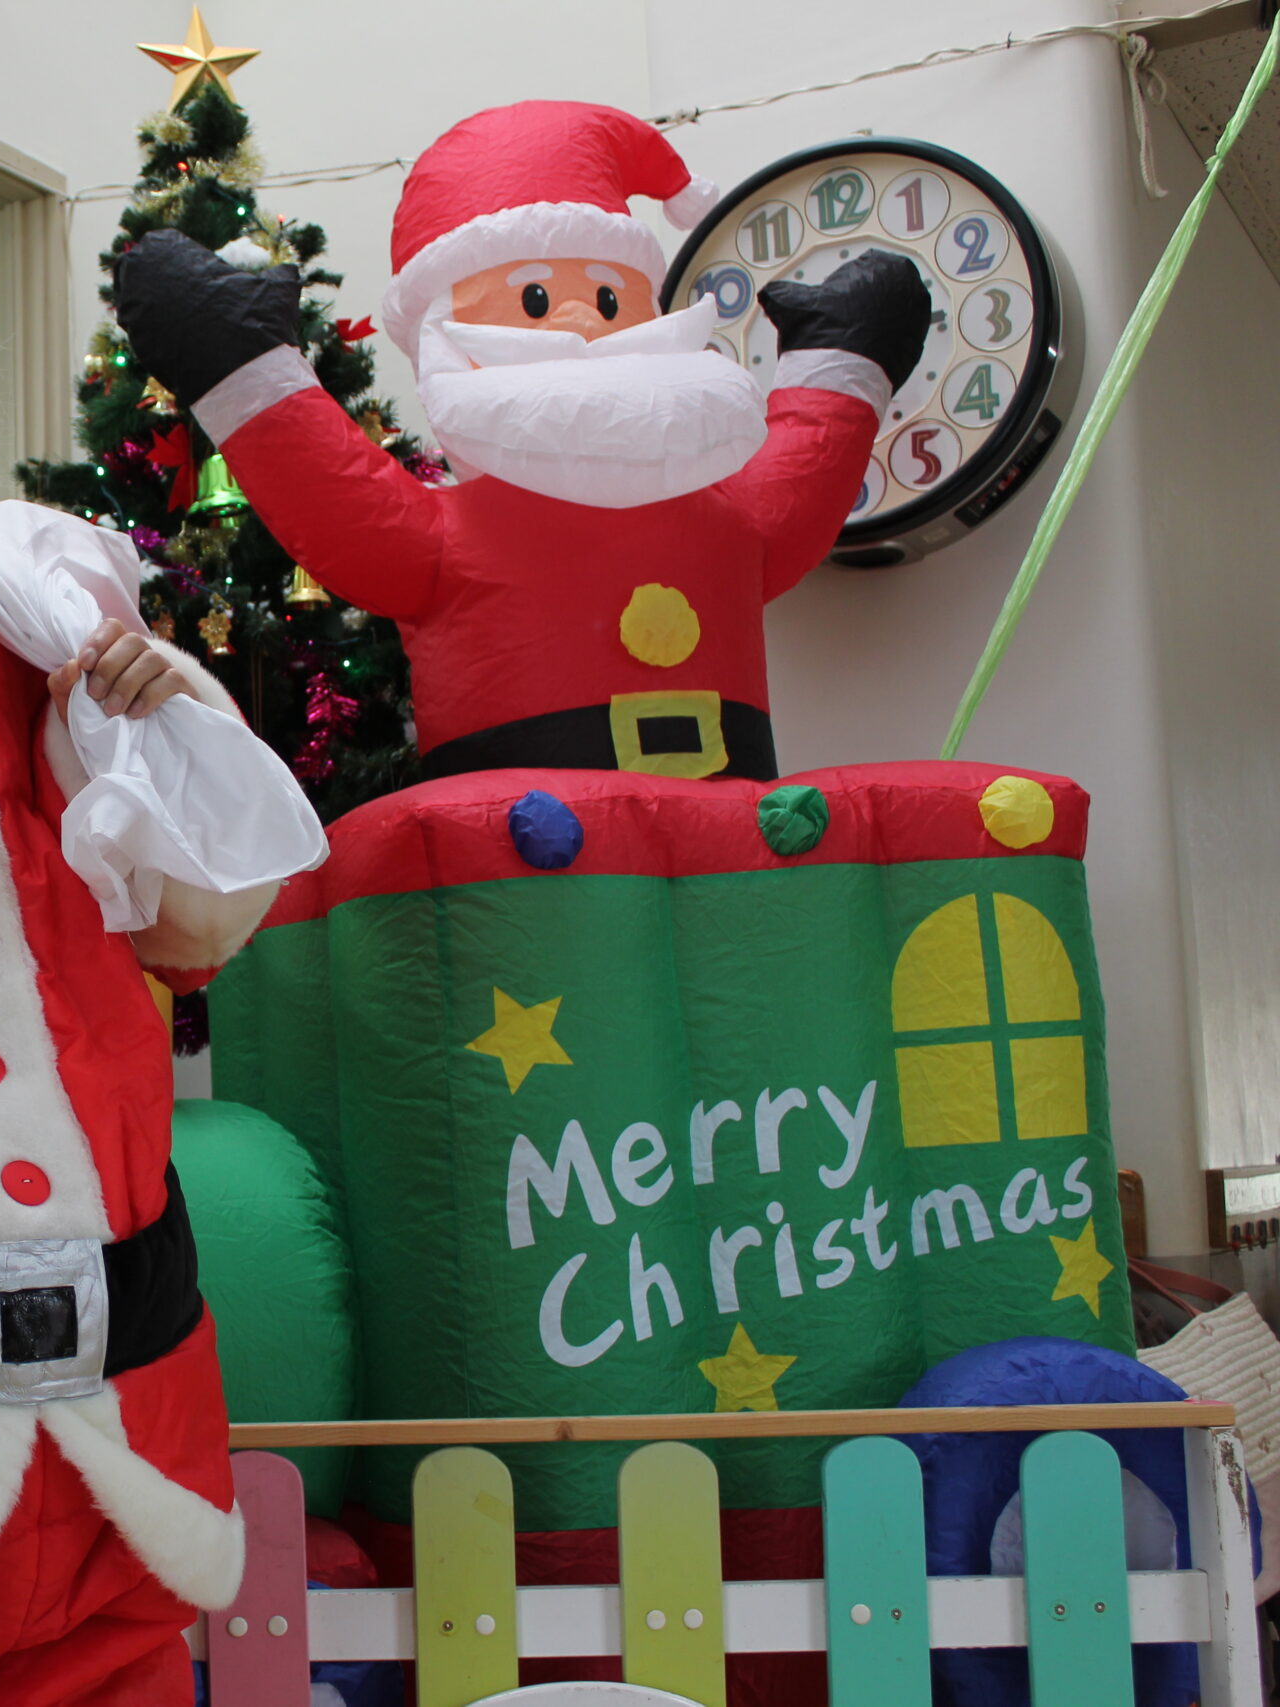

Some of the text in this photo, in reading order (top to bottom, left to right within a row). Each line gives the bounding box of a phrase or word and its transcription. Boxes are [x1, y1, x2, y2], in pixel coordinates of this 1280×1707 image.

[810, 172, 870, 229] 12
[894, 177, 925, 232] 1
[742, 207, 791, 263] 11
[953, 218, 995, 275] 2
[983, 289, 1012, 343] 3
[953, 364, 1000, 420] 4
[911, 428, 943, 485] 5
[506, 1080, 877, 1249] Merry
[538, 1156, 1093, 1367] Christmas
